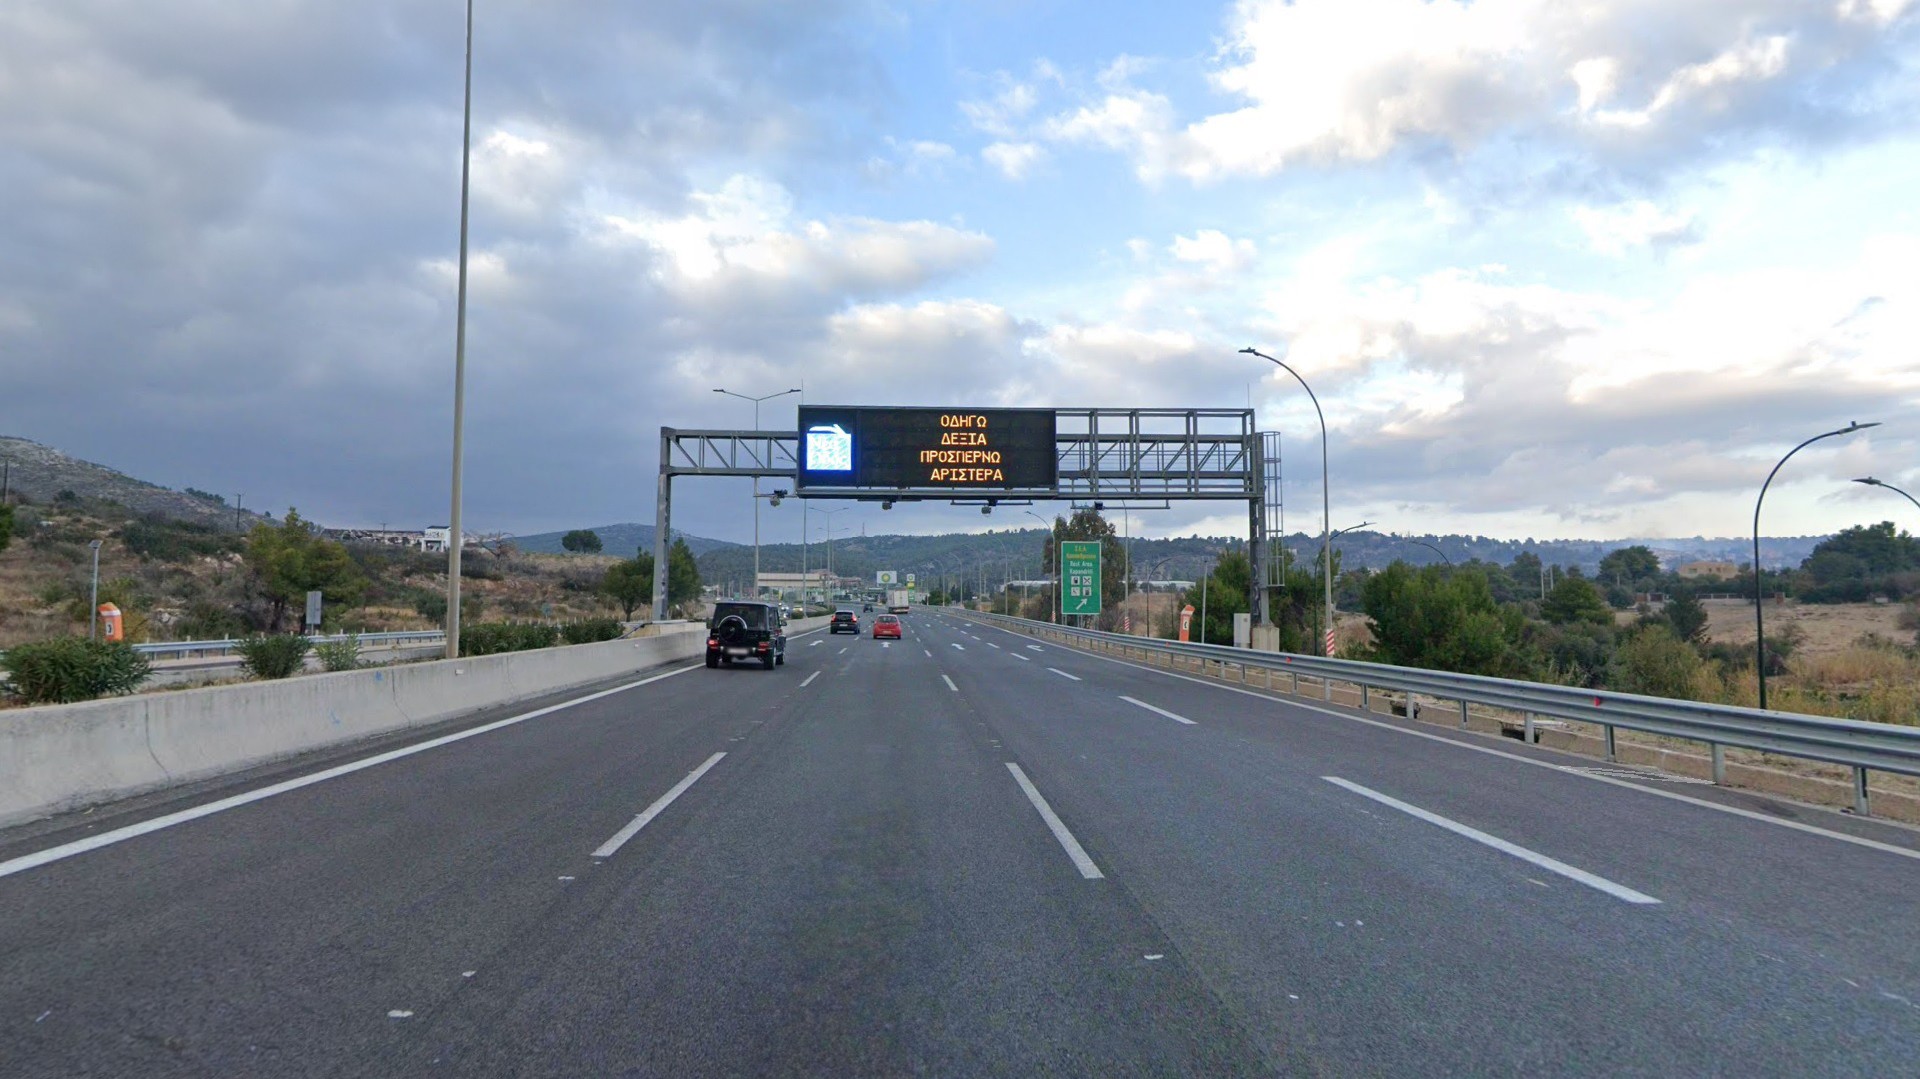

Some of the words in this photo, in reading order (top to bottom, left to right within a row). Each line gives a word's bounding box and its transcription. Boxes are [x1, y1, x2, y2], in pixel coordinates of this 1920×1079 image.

[941, 415, 987, 427] ΟΔΗΓΩ
[941, 432, 987, 445] ΔΕΞΙΑ
[920, 450, 1001, 463] ΠΡΟΣΠΕΡΝΩ
[930, 468, 1003, 481] ΑΡΙΣΤΕΡΑ
